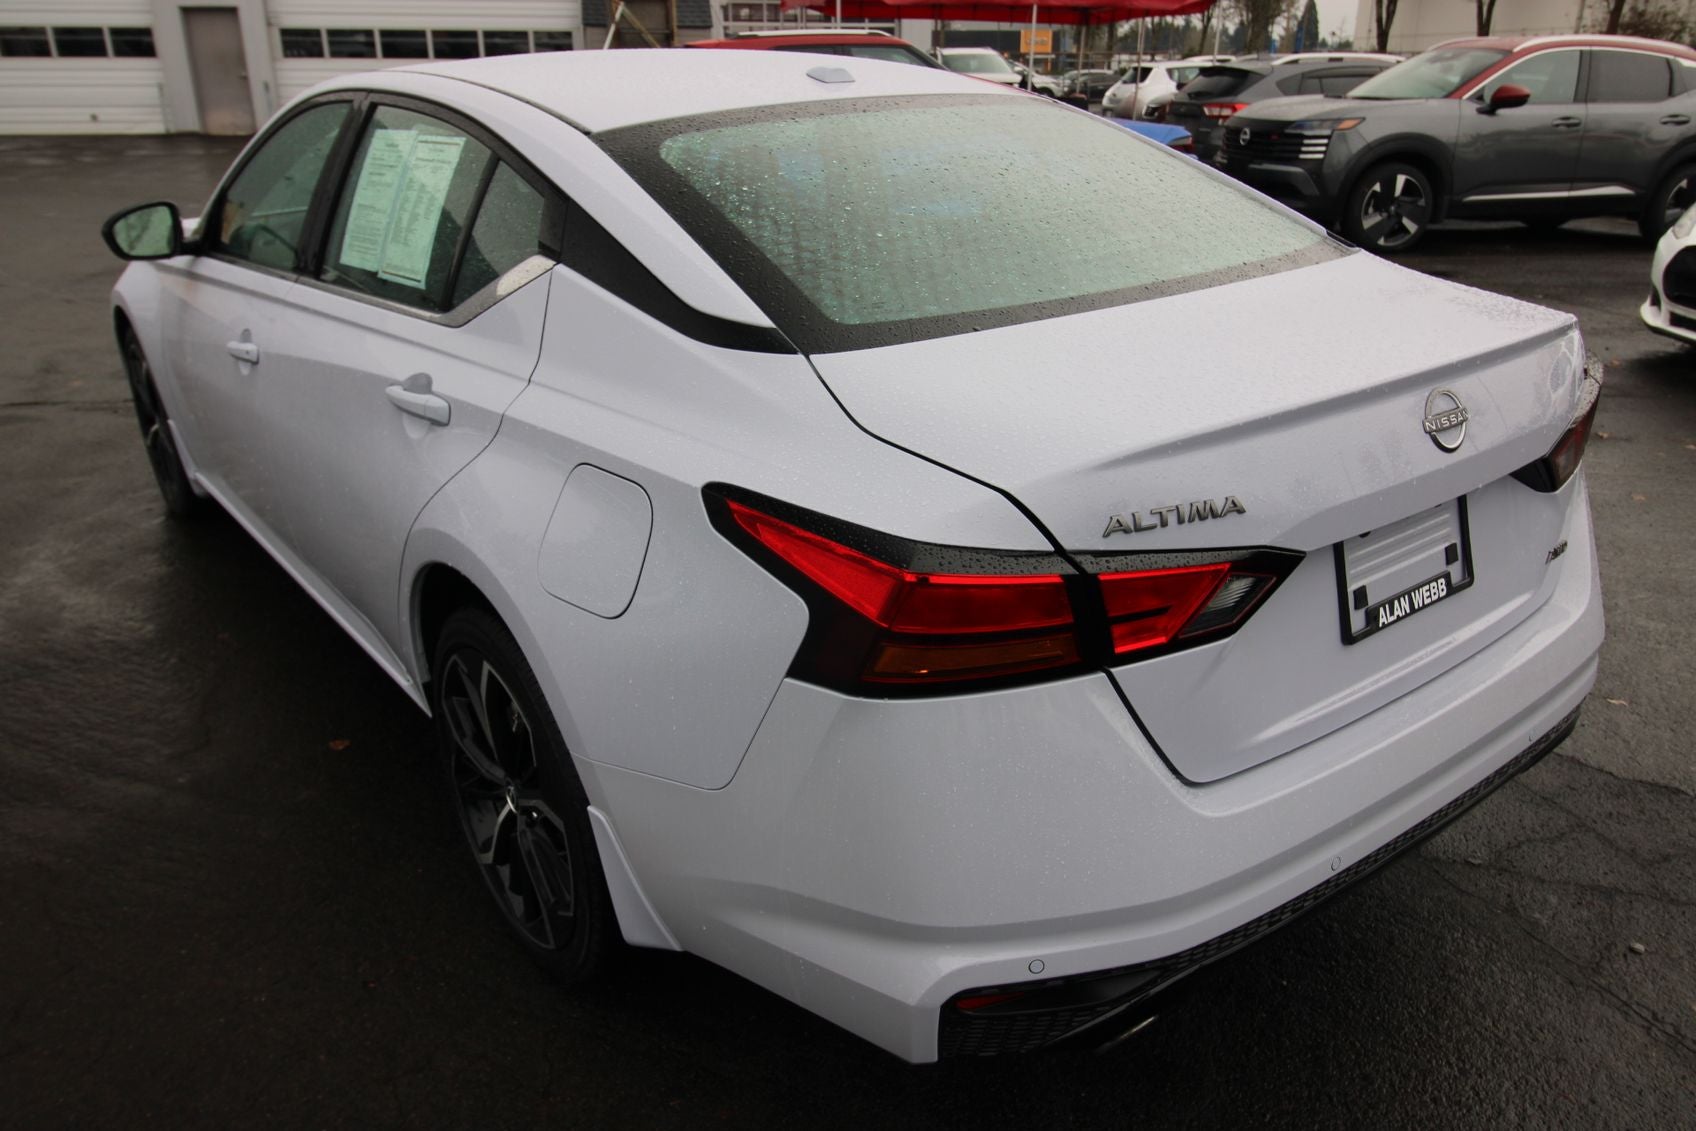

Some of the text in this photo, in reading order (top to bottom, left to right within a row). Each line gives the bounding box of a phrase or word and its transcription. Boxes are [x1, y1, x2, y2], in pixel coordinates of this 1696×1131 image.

[1424, 409, 1469, 431] NISSAN
[1102, 495, 1247, 538] ALTIMA
[1379, 577, 1447, 628] ALAN WEBB
